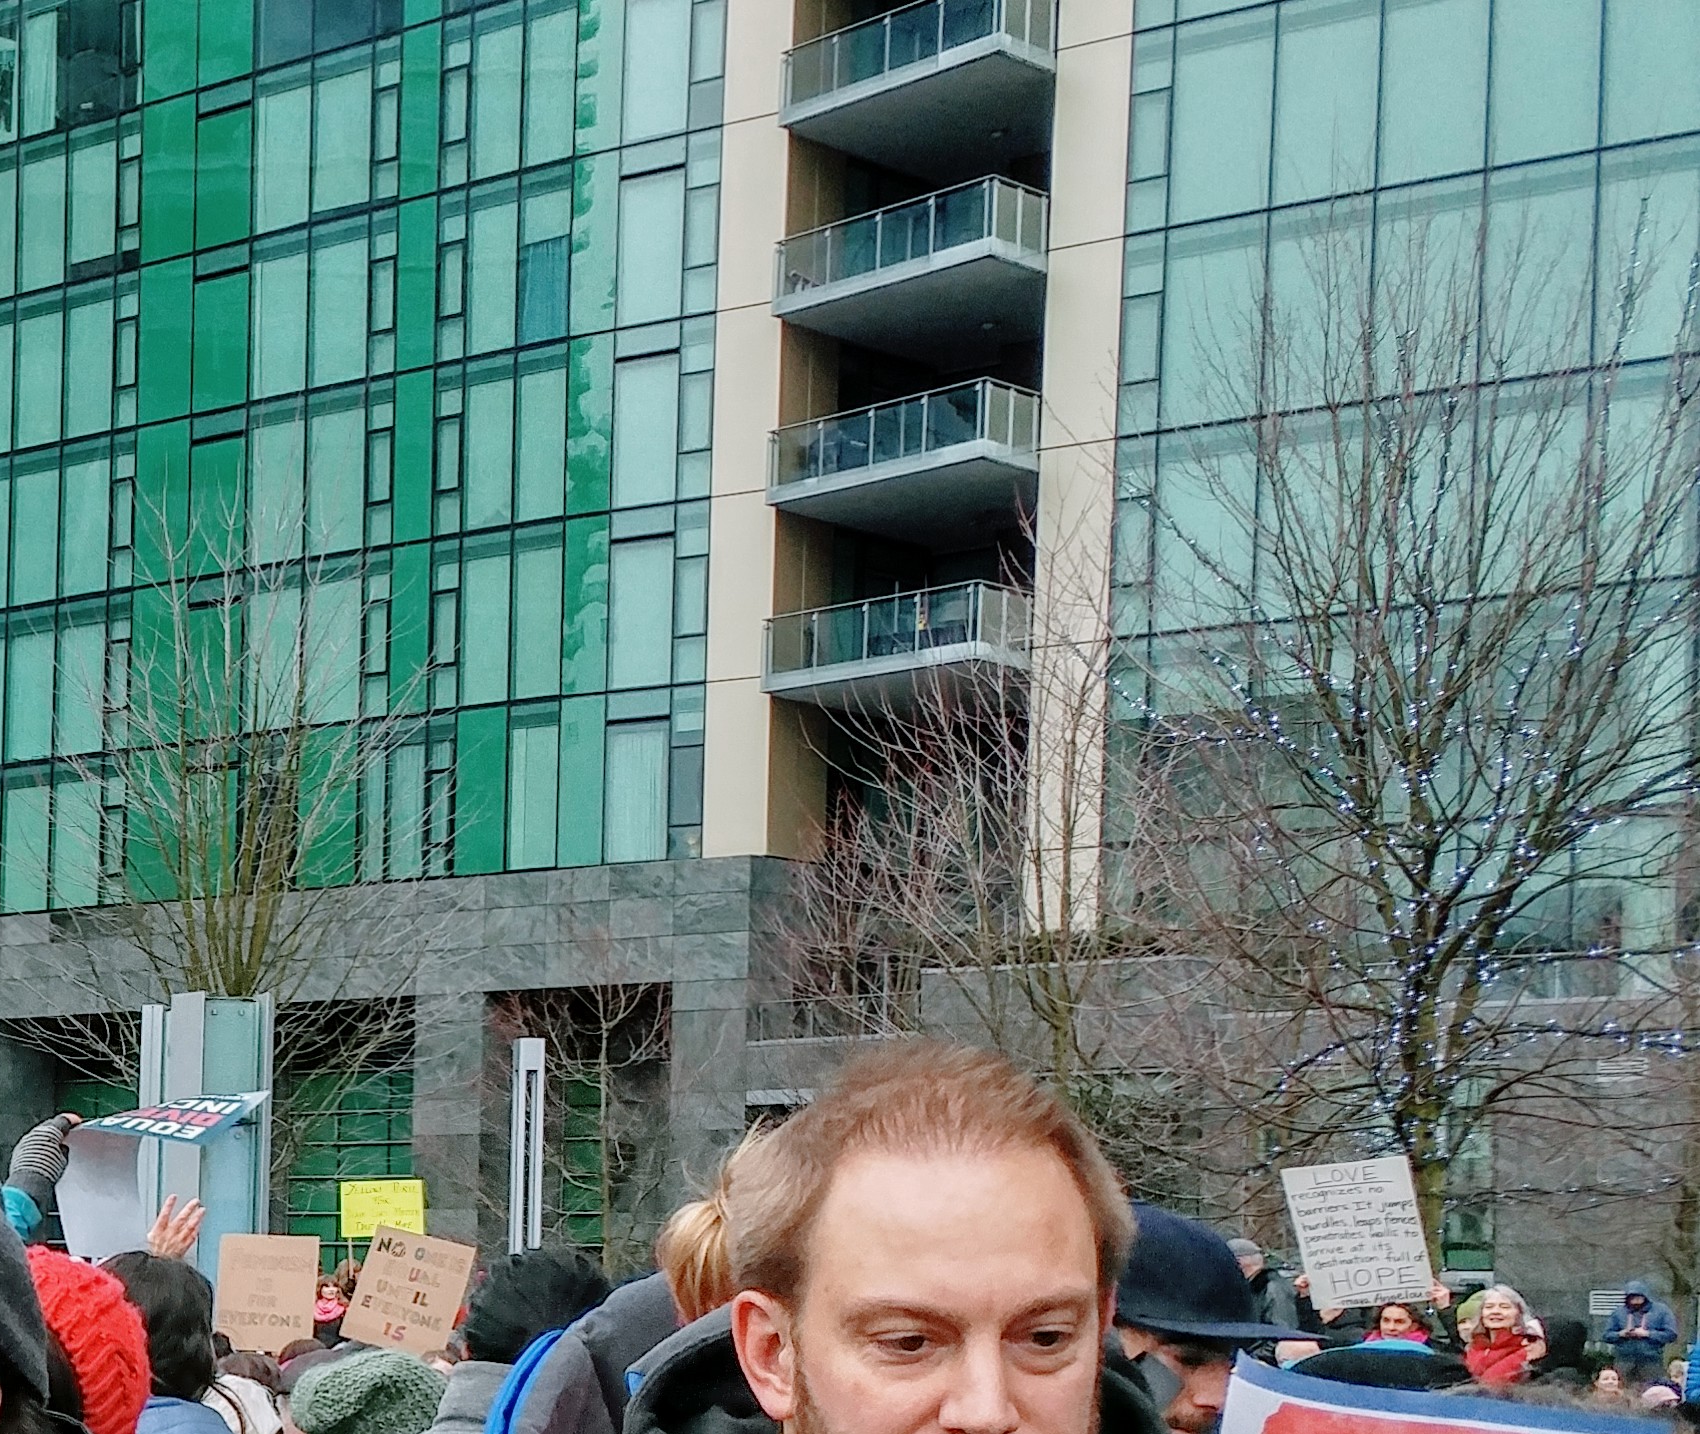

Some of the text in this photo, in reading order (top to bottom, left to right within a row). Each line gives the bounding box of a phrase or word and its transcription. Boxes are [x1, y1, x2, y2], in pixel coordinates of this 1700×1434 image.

[115, 1107, 225, 1127] DIVE
[1313, 1165, 1378, 1186] LOVE
[1291, 1186, 1384, 1203] recognizes no
[1352, 1200, 1372, 1211] It
[1378, 1199, 1414, 1213] jumps
[1352, 1215, 1383, 1233] leaps
[1403, 1229, 1419, 1238] to
[377, 1237, 407, 1258] NO
[414, 1247, 446, 1269] ONE
[1351, 1243, 1365, 1253] at
[1372, 1241, 1392, 1251] its
[1385, 1252, 1410, 1264] full
[1414, 1250, 1426, 1263] of
[382, 1259, 441, 1288] EQUAL
[1330, 1265, 1420, 1294] HOPE
[376, 1278, 429, 1307] UNTIL
[219, 1308, 301, 1328] EVERYONE
[360, 1294, 443, 1332] EVERYONE
[383, 1321, 408, 1341] IS
